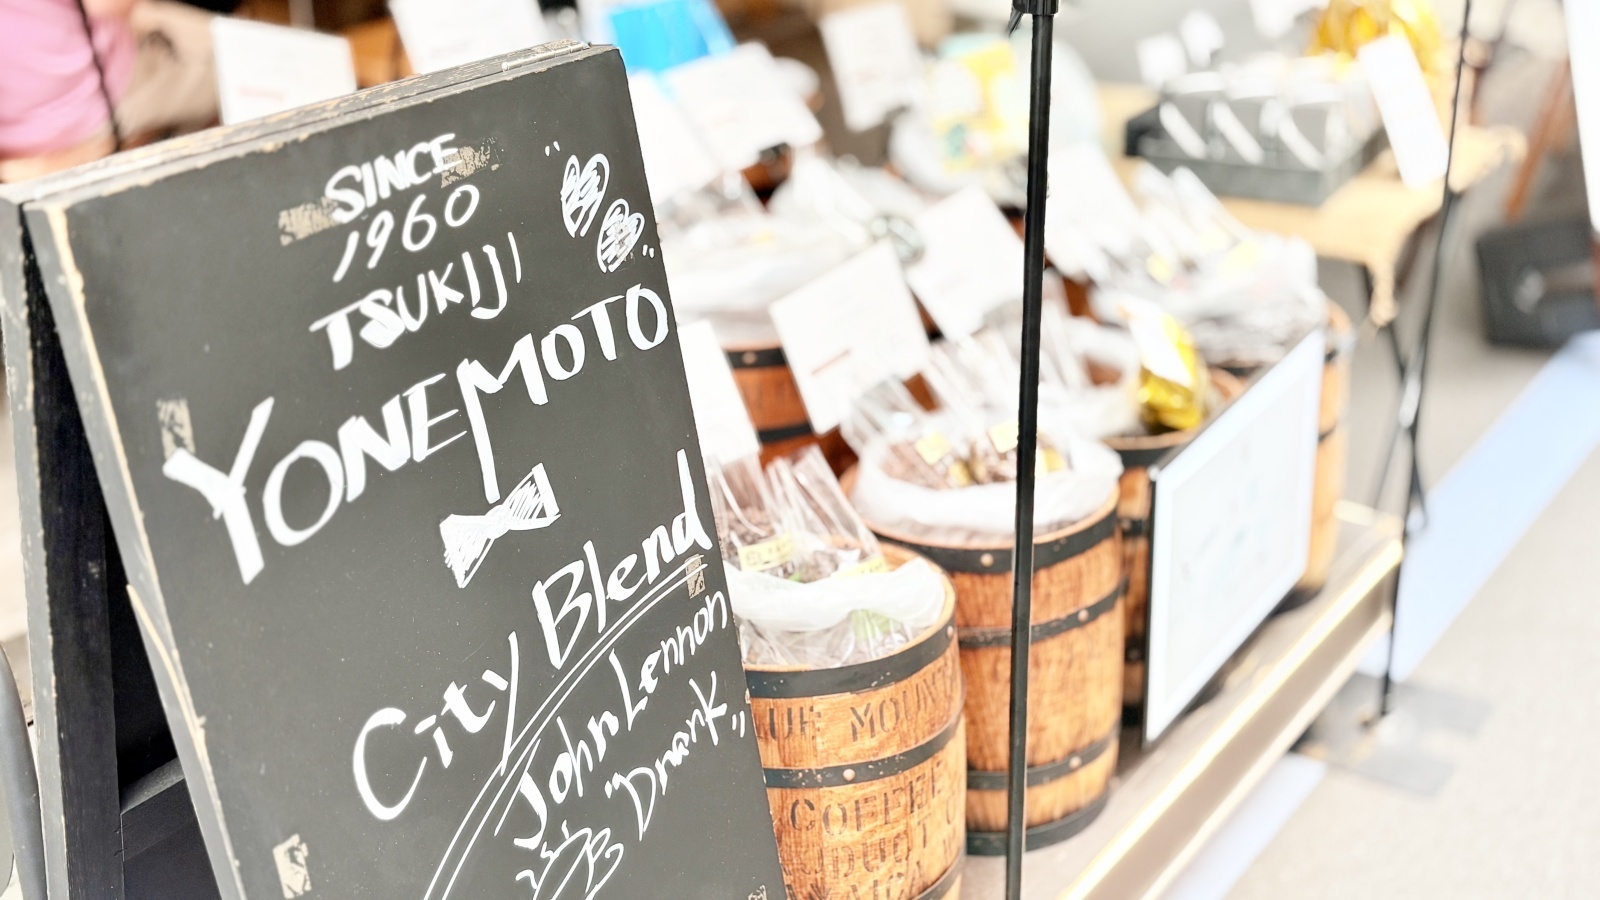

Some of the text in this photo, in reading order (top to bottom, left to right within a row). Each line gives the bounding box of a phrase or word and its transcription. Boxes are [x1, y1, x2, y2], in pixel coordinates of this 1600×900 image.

[325, 133, 464, 224] SINCE
[332, 184, 480, 283] 1960
[309, 231, 523, 371] TSUKIJI
[163, 283, 669, 585] YONEMOTO
[353, 448, 713, 821] City Blend
[513, 710, 619, 850] John
[608, 590, 728, 732] Lennon
